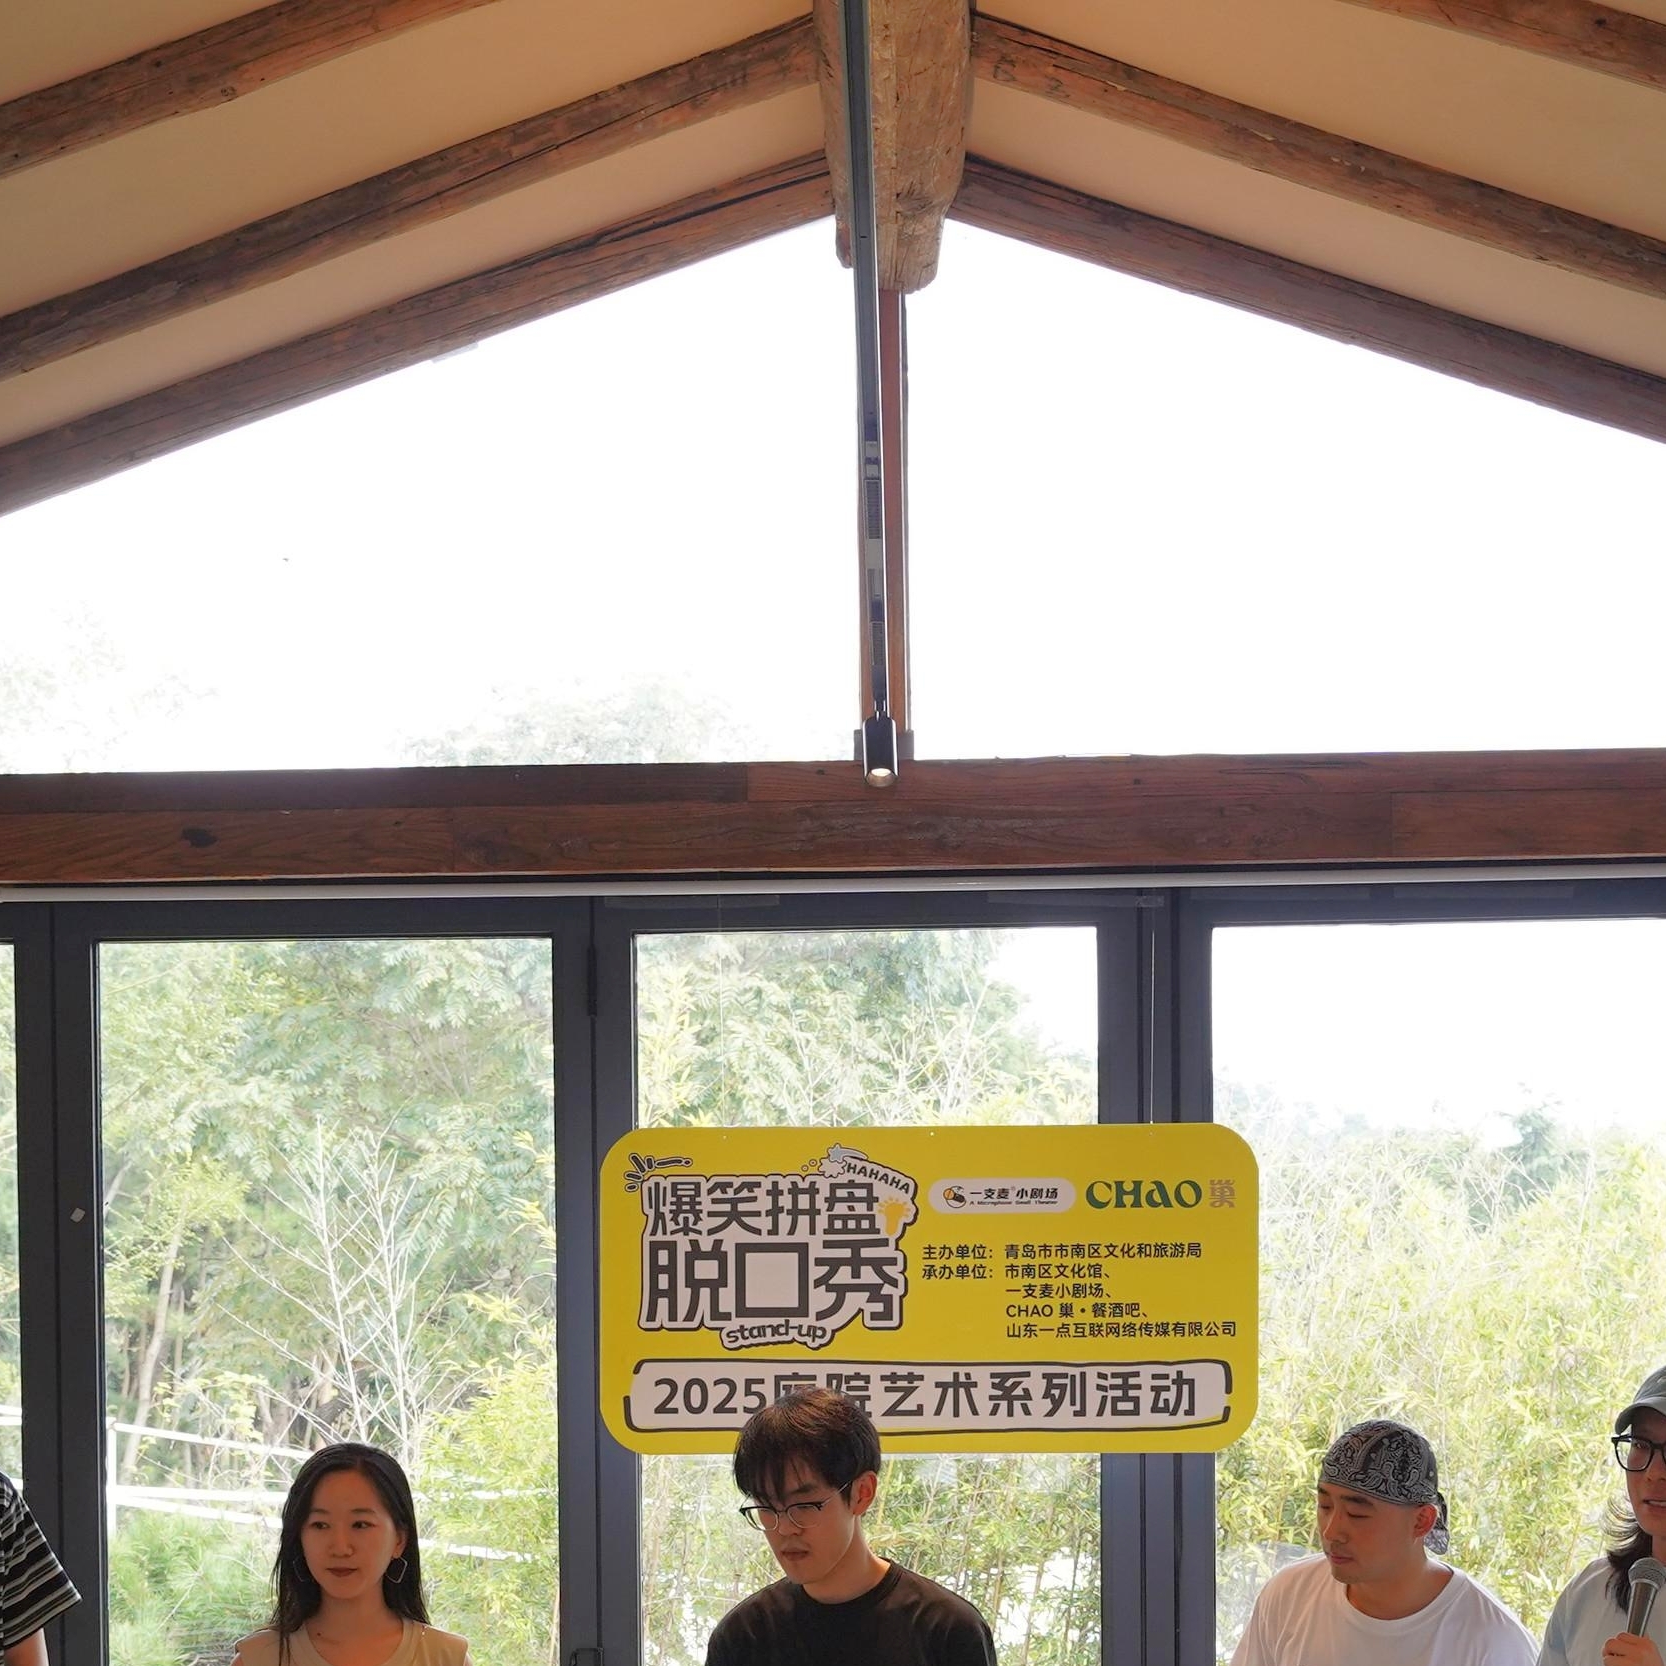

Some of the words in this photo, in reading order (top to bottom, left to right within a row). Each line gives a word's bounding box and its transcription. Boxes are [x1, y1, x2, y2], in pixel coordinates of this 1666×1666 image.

[846, 1162, 911, 1194] HAHAHA
[647, 1179, 881, 1237] 爆笑拼盘
[645, 1237, 899, 1323] 脱口秀
[1005, 1304, 1054, 1318] CHAO
[725, 1318, 828, 1343] stand-up
[1006, 1321, 1237, 1339] 山东一点互联网络传媒有限公司
